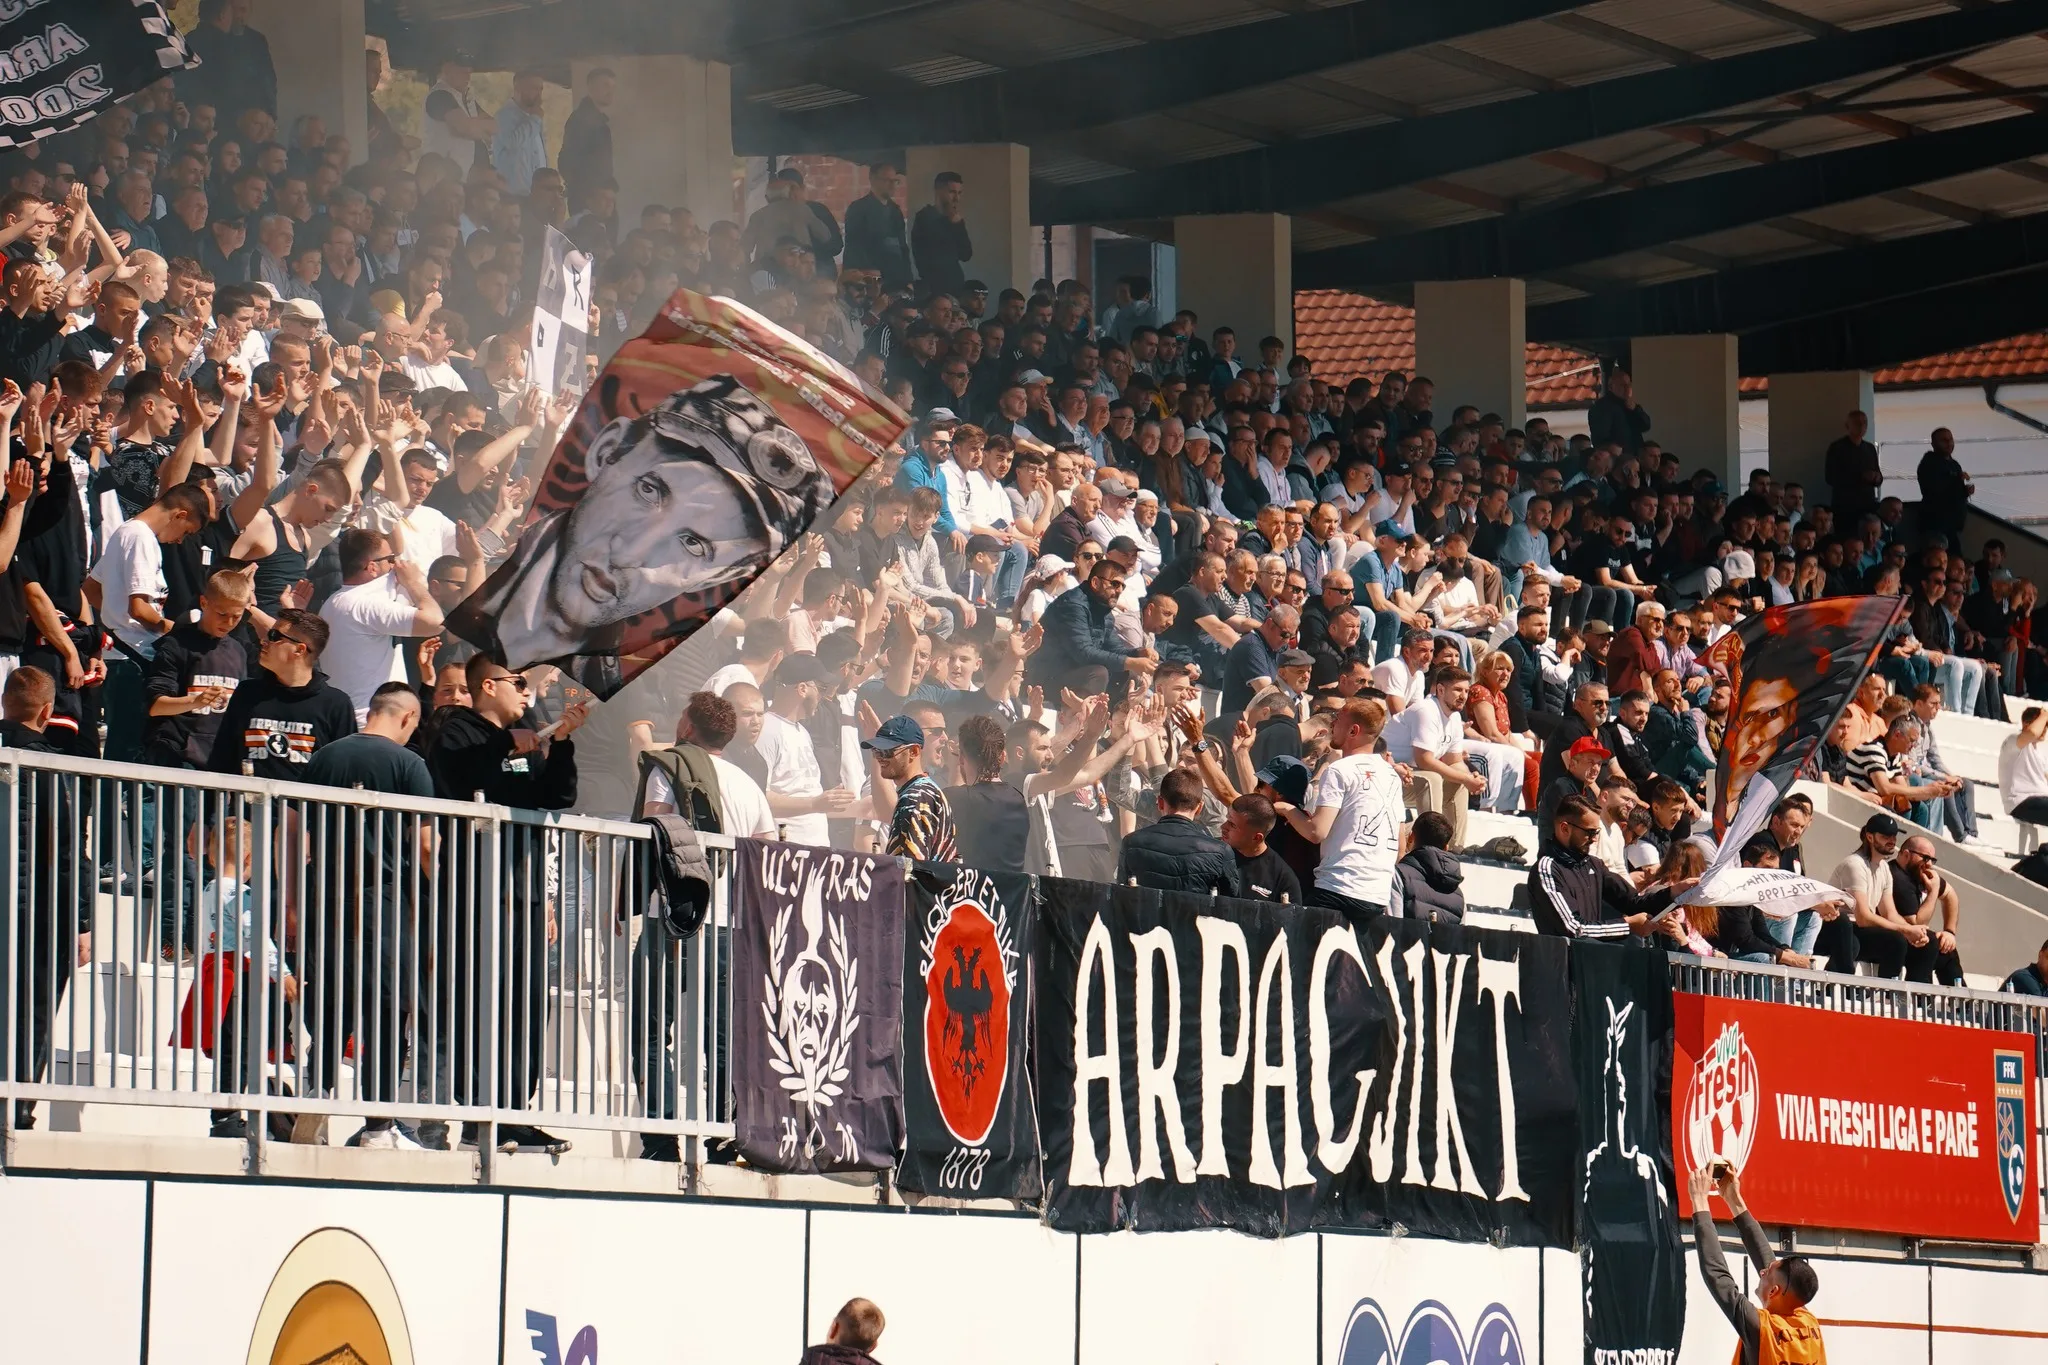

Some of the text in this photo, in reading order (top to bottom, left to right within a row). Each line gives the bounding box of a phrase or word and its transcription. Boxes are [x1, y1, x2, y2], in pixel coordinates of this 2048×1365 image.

[192, 674, 240, 690] ARPAGJIK
[1068, 911, 1531, 1202] ARPAGJIKT
[1693, 1034, 1751, 1123] Fresh
[2002, 1061, 2017, 1079] FFK
[1775, 1092, 1979, 1158] VIVA FRESH LIGA E PARË
[938, 1146, 991, 1191] 1878
